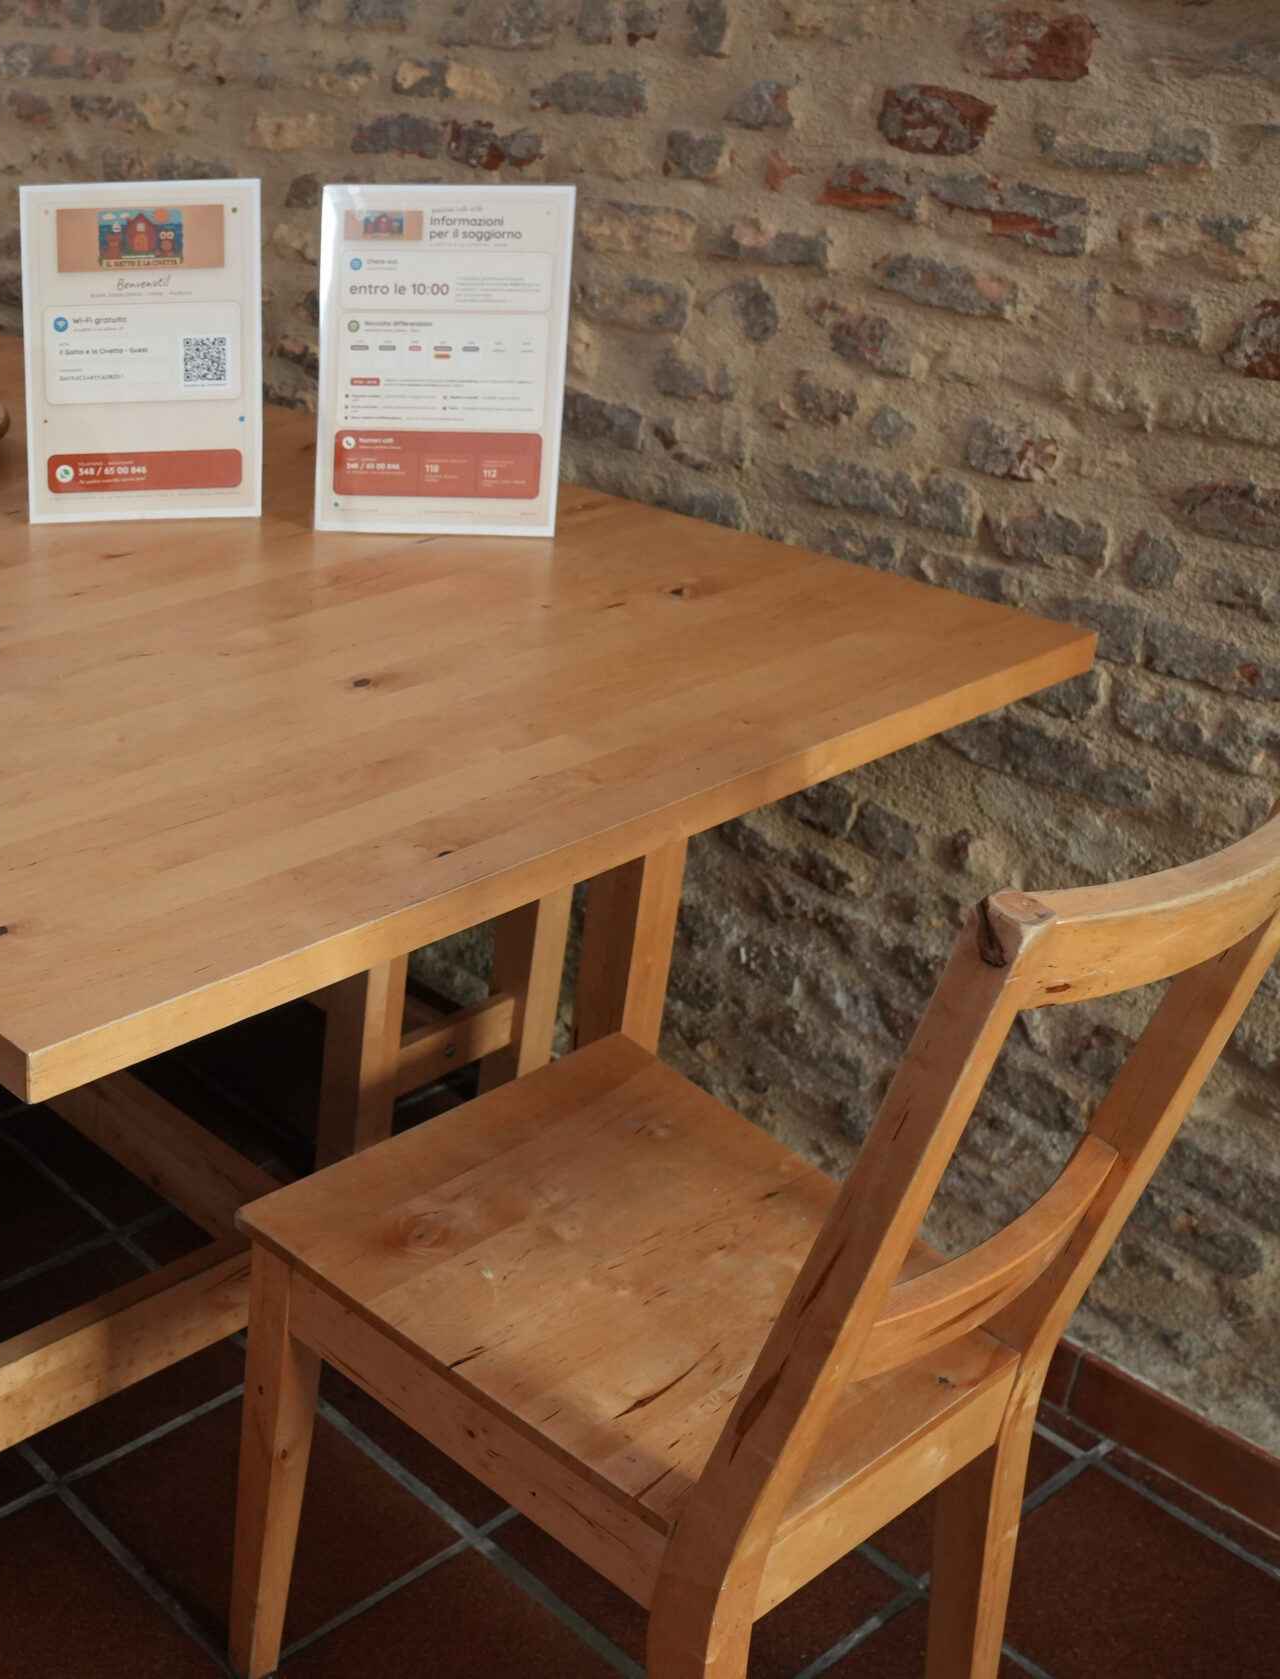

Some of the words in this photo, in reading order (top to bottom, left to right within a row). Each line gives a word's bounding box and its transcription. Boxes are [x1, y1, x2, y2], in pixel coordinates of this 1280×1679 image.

[430, 216, 504, 226] Informazioni
[429, 230, 449, 240] per
[452, 228, 459, 238] il
[462, 229, 522, 241] soggiorno
[116, 274, 171, 291] Benvenuti!
[349, 284, 390, 295] entro
[394, 282, 407, 295] le
[412, 283, 449, 296] 10:00
[94, 317, 127, 325] gratuito
[78, 467, 95, 476] 348
[96, 466, 103, 476] /
[104, 467, 115, 475] 65
[117, 466, 129, 475] 00
[131, 465, 147, 474] 846
